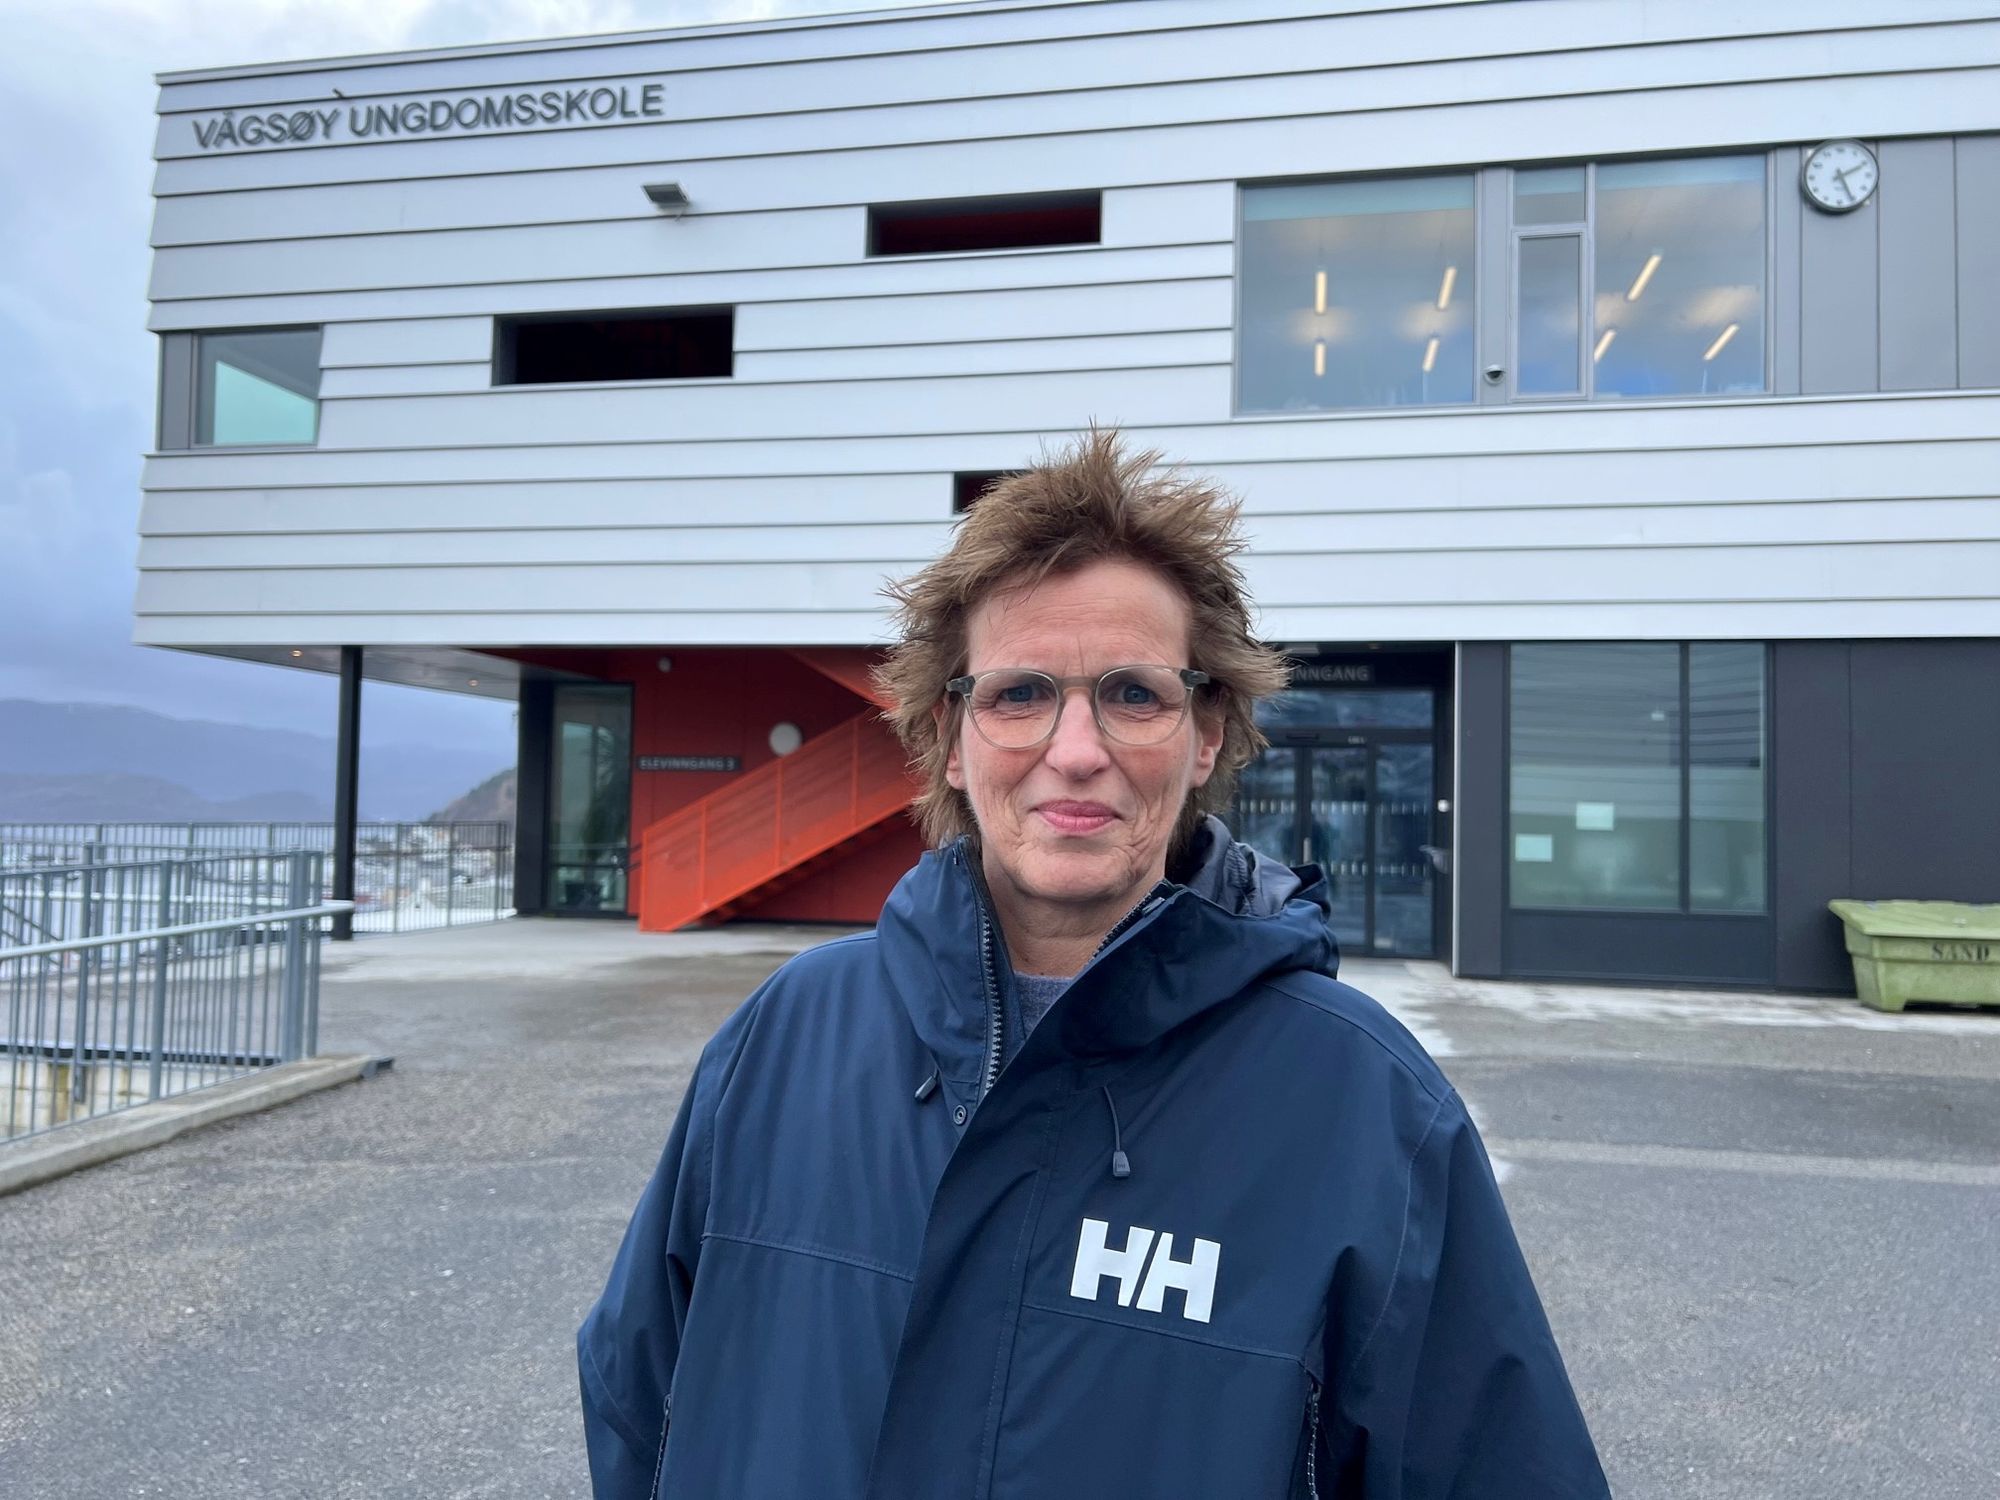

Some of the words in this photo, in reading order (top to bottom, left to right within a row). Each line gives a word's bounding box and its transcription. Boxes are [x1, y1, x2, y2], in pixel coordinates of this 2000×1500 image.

[192, 107, 341, 148] VÅGSØY
[350, 83, 665, 137] UNGDOMSSKOLE
[1931, 943, 1990, 962] SAND
[1070, 1217, 1221, 1323] HH
